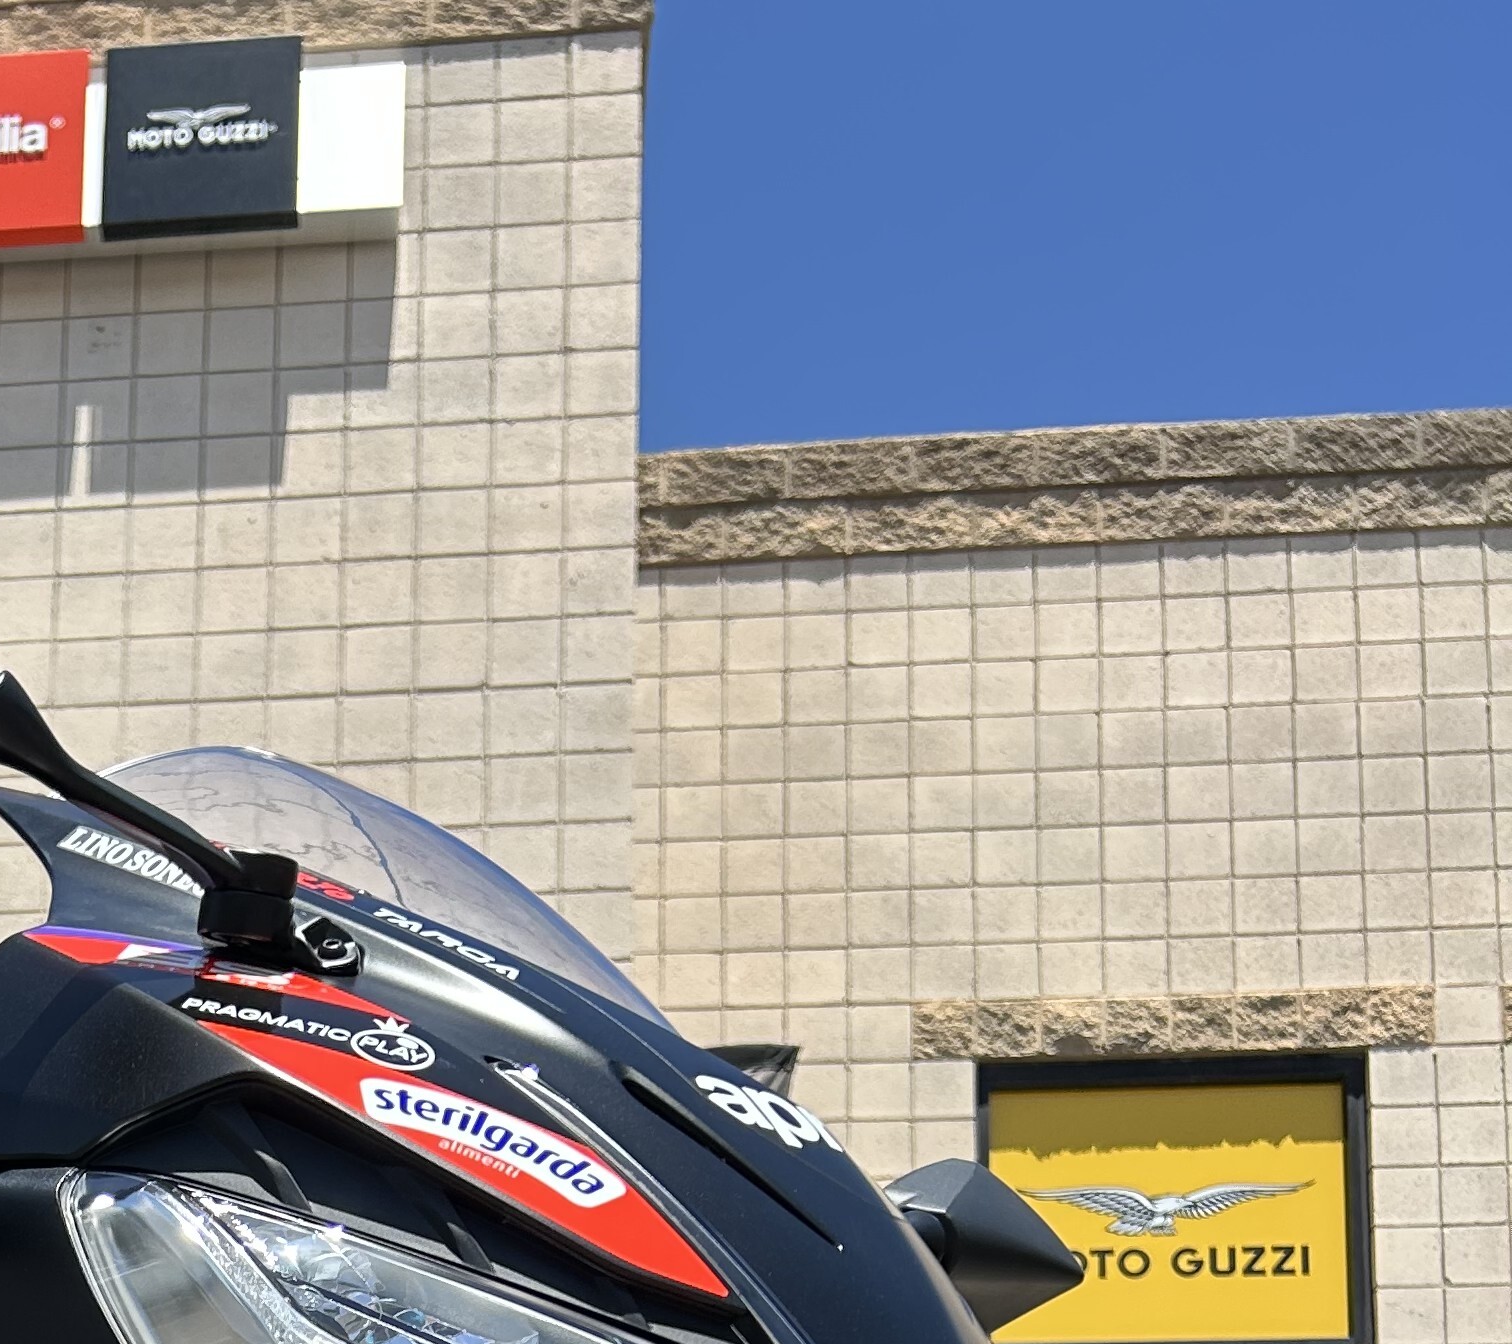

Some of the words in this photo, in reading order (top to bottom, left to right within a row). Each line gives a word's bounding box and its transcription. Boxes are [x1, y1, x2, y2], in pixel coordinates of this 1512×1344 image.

[127, 127, 194, 152] MOTO
[198, 119, 270, 146] GUZZI
[181, 996, 352, 1043] PRAGMATIC
[359, 1032, 428, 1066] PLAY
[374, 1085, 605, 1196] sterilgarda
[438, 1136, 521, 1180] alimenti
[1171, 1243, 1311, 1279] GUZZI
